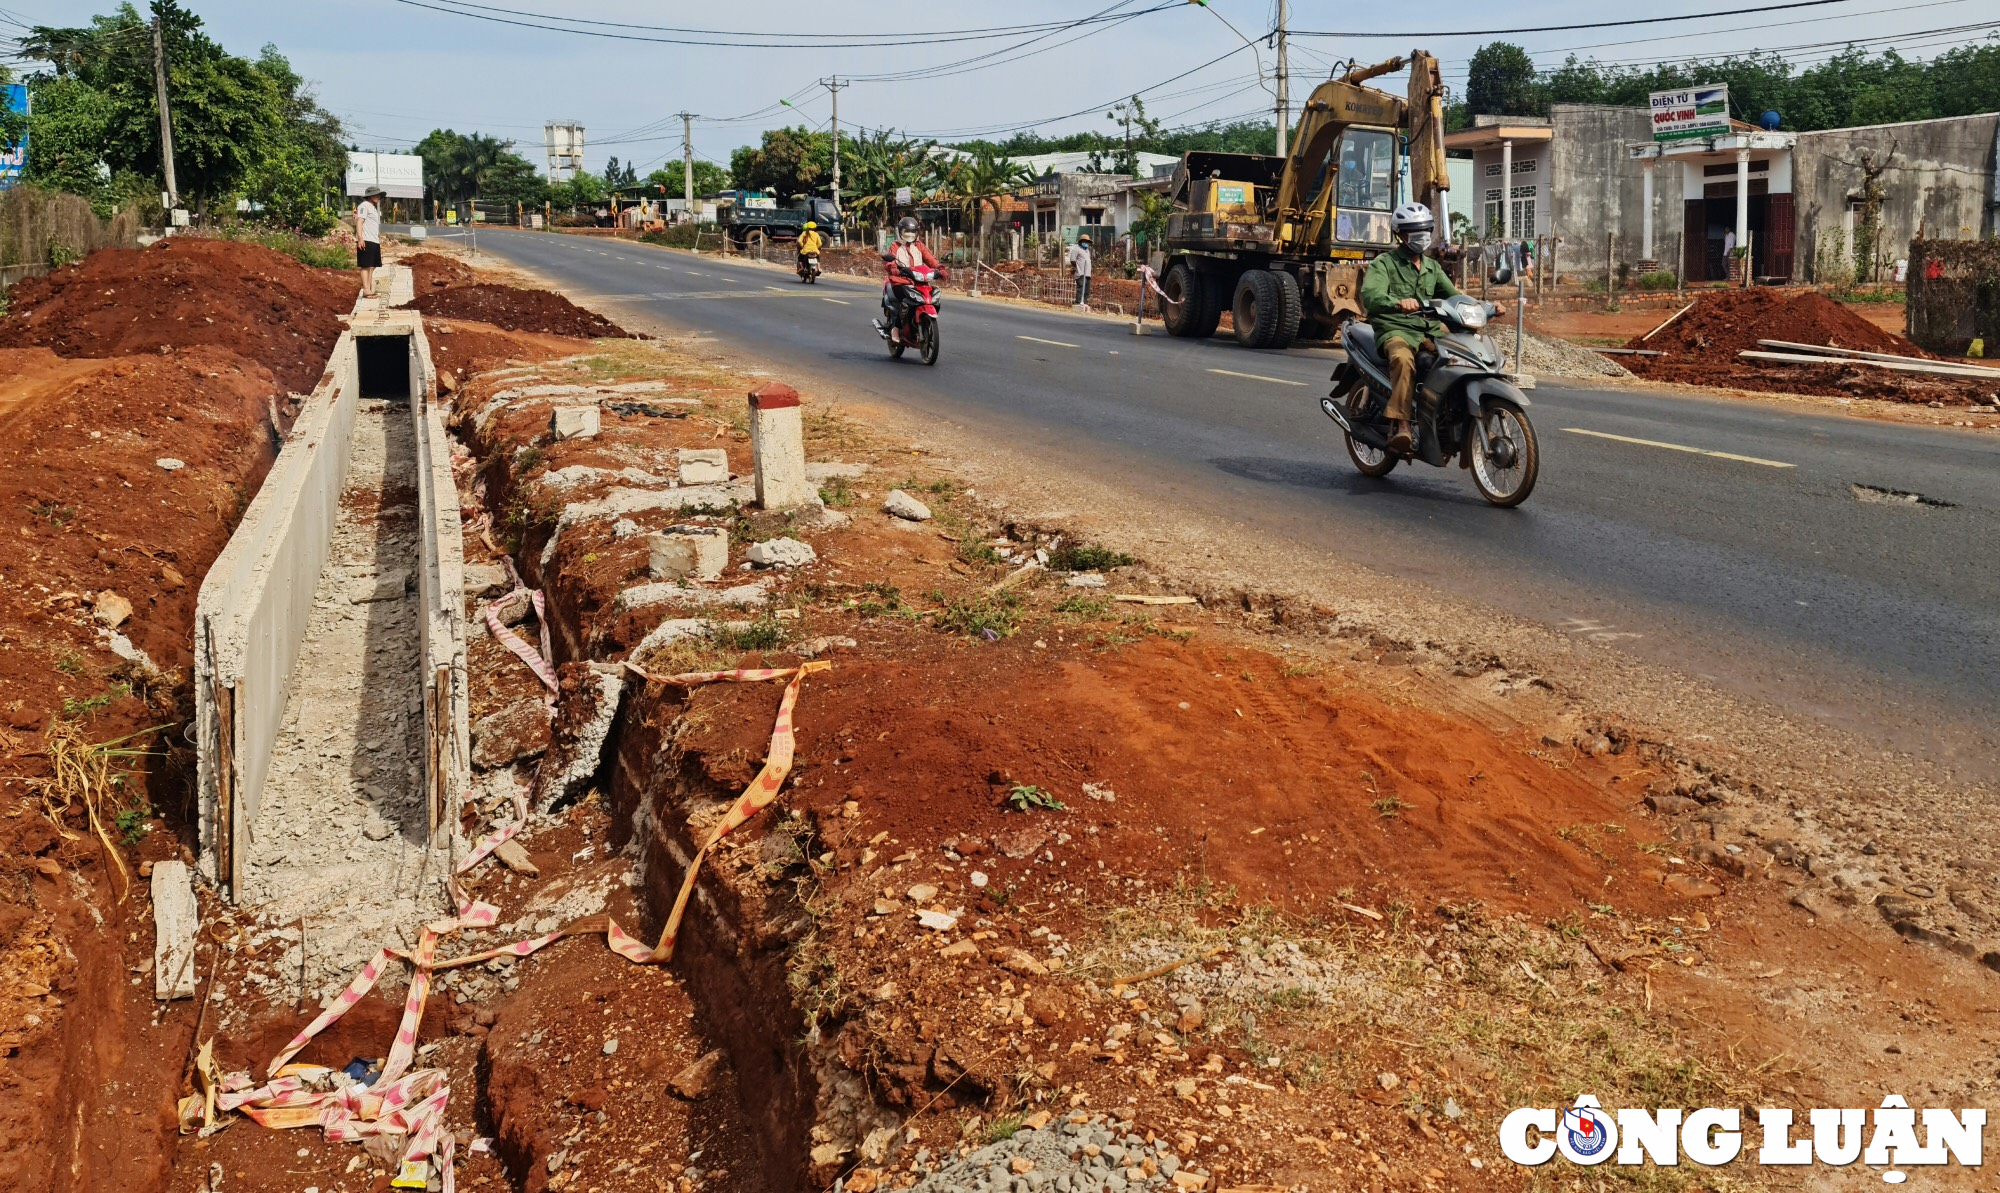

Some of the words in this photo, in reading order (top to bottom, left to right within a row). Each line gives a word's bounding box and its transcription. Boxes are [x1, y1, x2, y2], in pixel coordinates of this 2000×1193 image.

[1652, 95, 1674, 108] ĐIỆN
[1677, 92, 1688, 103] TỬ
[1654, 108, 1675, 123] QUỐC
[1677, 109, 1695, 121] VINH
